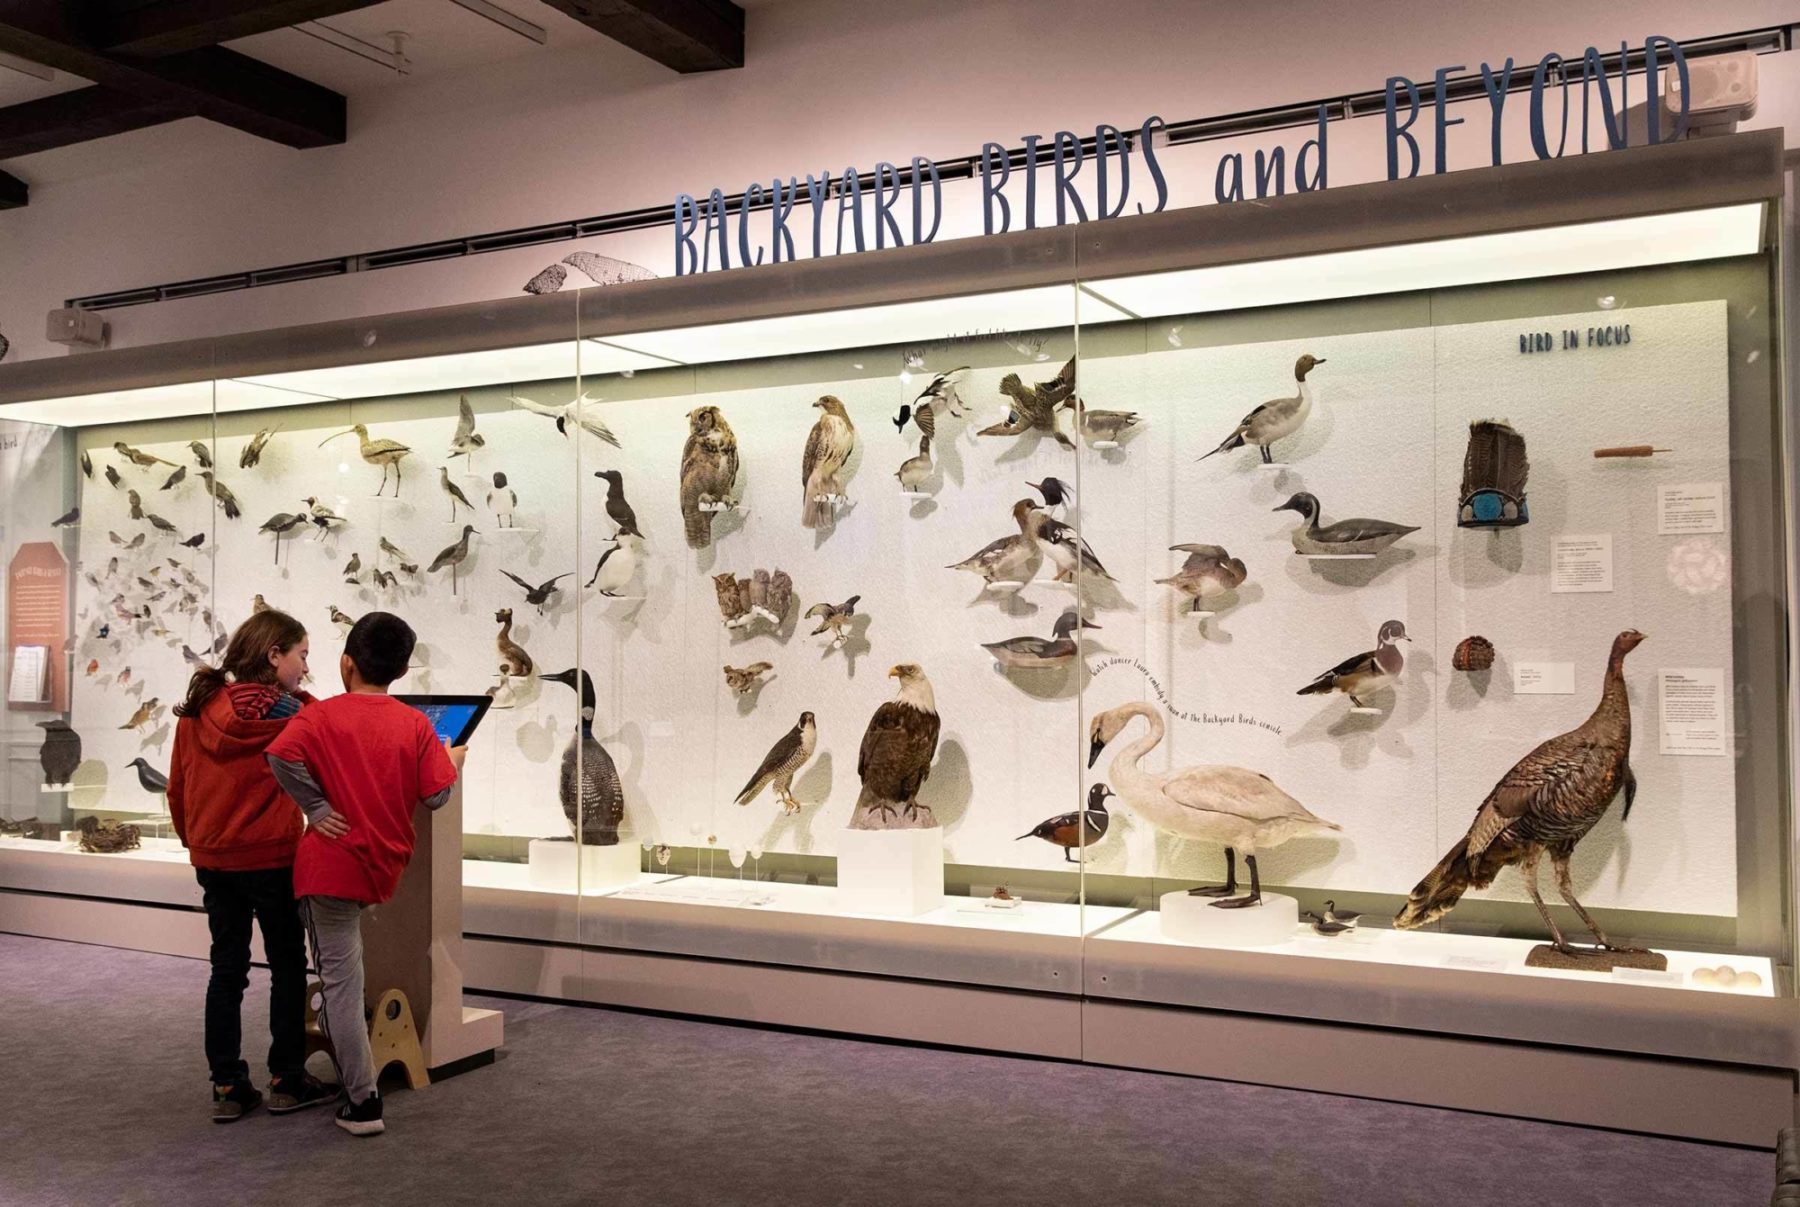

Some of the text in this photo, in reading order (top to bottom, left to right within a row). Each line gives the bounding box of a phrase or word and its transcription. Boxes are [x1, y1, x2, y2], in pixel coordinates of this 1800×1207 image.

[674, 156, 942, 276] BACKYARD
[982, 115, 1168, 236] BIRDS
[1215, 104, 1328, 203] and
[1520, 323, 1631, 354] BIRD IN FOCUS
[1203, 712, 1235, 726] Backyard
[1238, 712, 1257, 726] Birds
